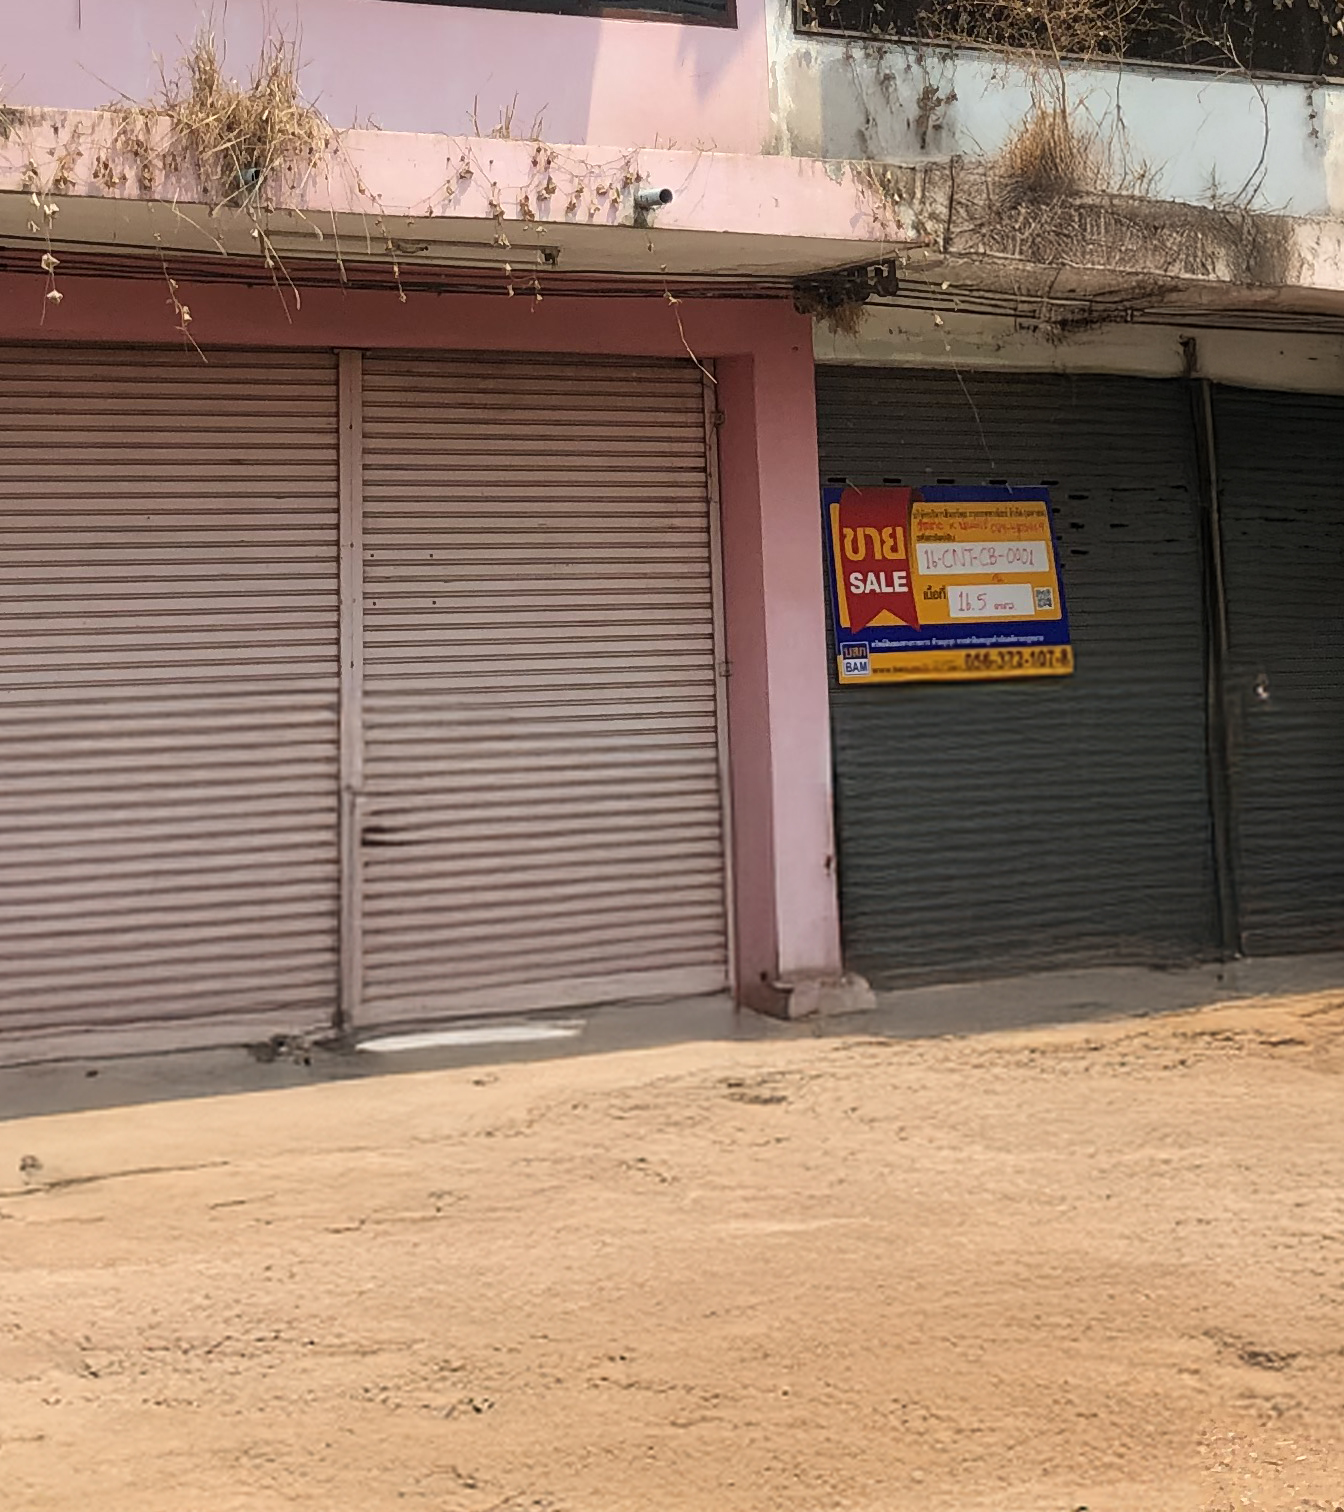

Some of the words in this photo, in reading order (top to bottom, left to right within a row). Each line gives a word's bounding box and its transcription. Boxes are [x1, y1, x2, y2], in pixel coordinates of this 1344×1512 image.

[843, 526, 907, 561] ขาย
[849, 570, 909, 594] SALE
[958, 590, 988, 612] 16.5
[845, 661, 868, 673] BAM
